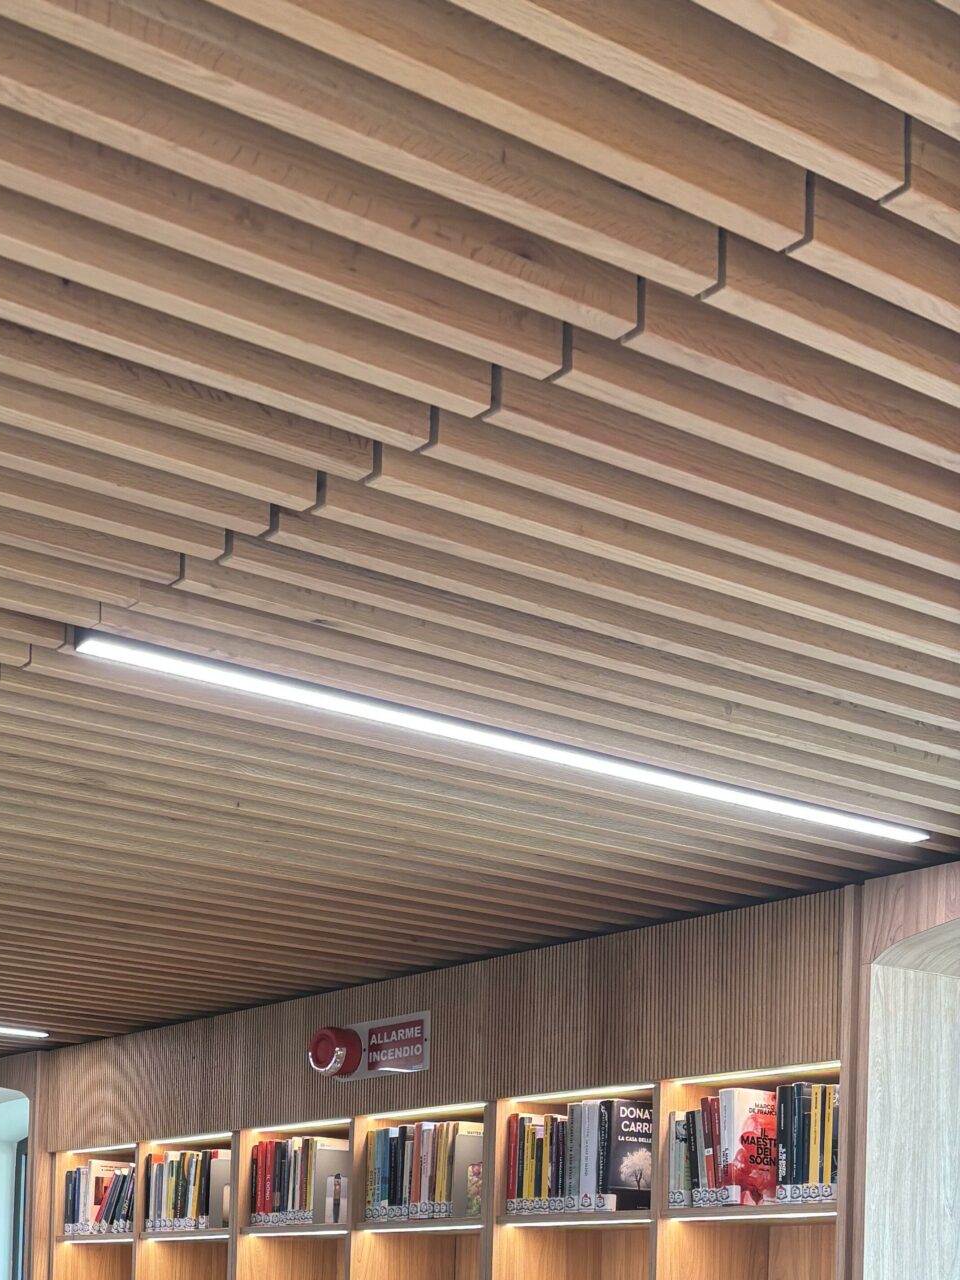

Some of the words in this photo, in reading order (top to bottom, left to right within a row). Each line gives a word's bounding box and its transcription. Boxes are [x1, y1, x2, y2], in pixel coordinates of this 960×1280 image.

[370, 1026, 421, 1045] ALLARME
[369, 1044, 422, 1063] INCENDIO
[621, 1120, 652, 1134] CARRI
[760, 1128, 769, 1138] IL
[756, 1146, 772, 1157] DEI
